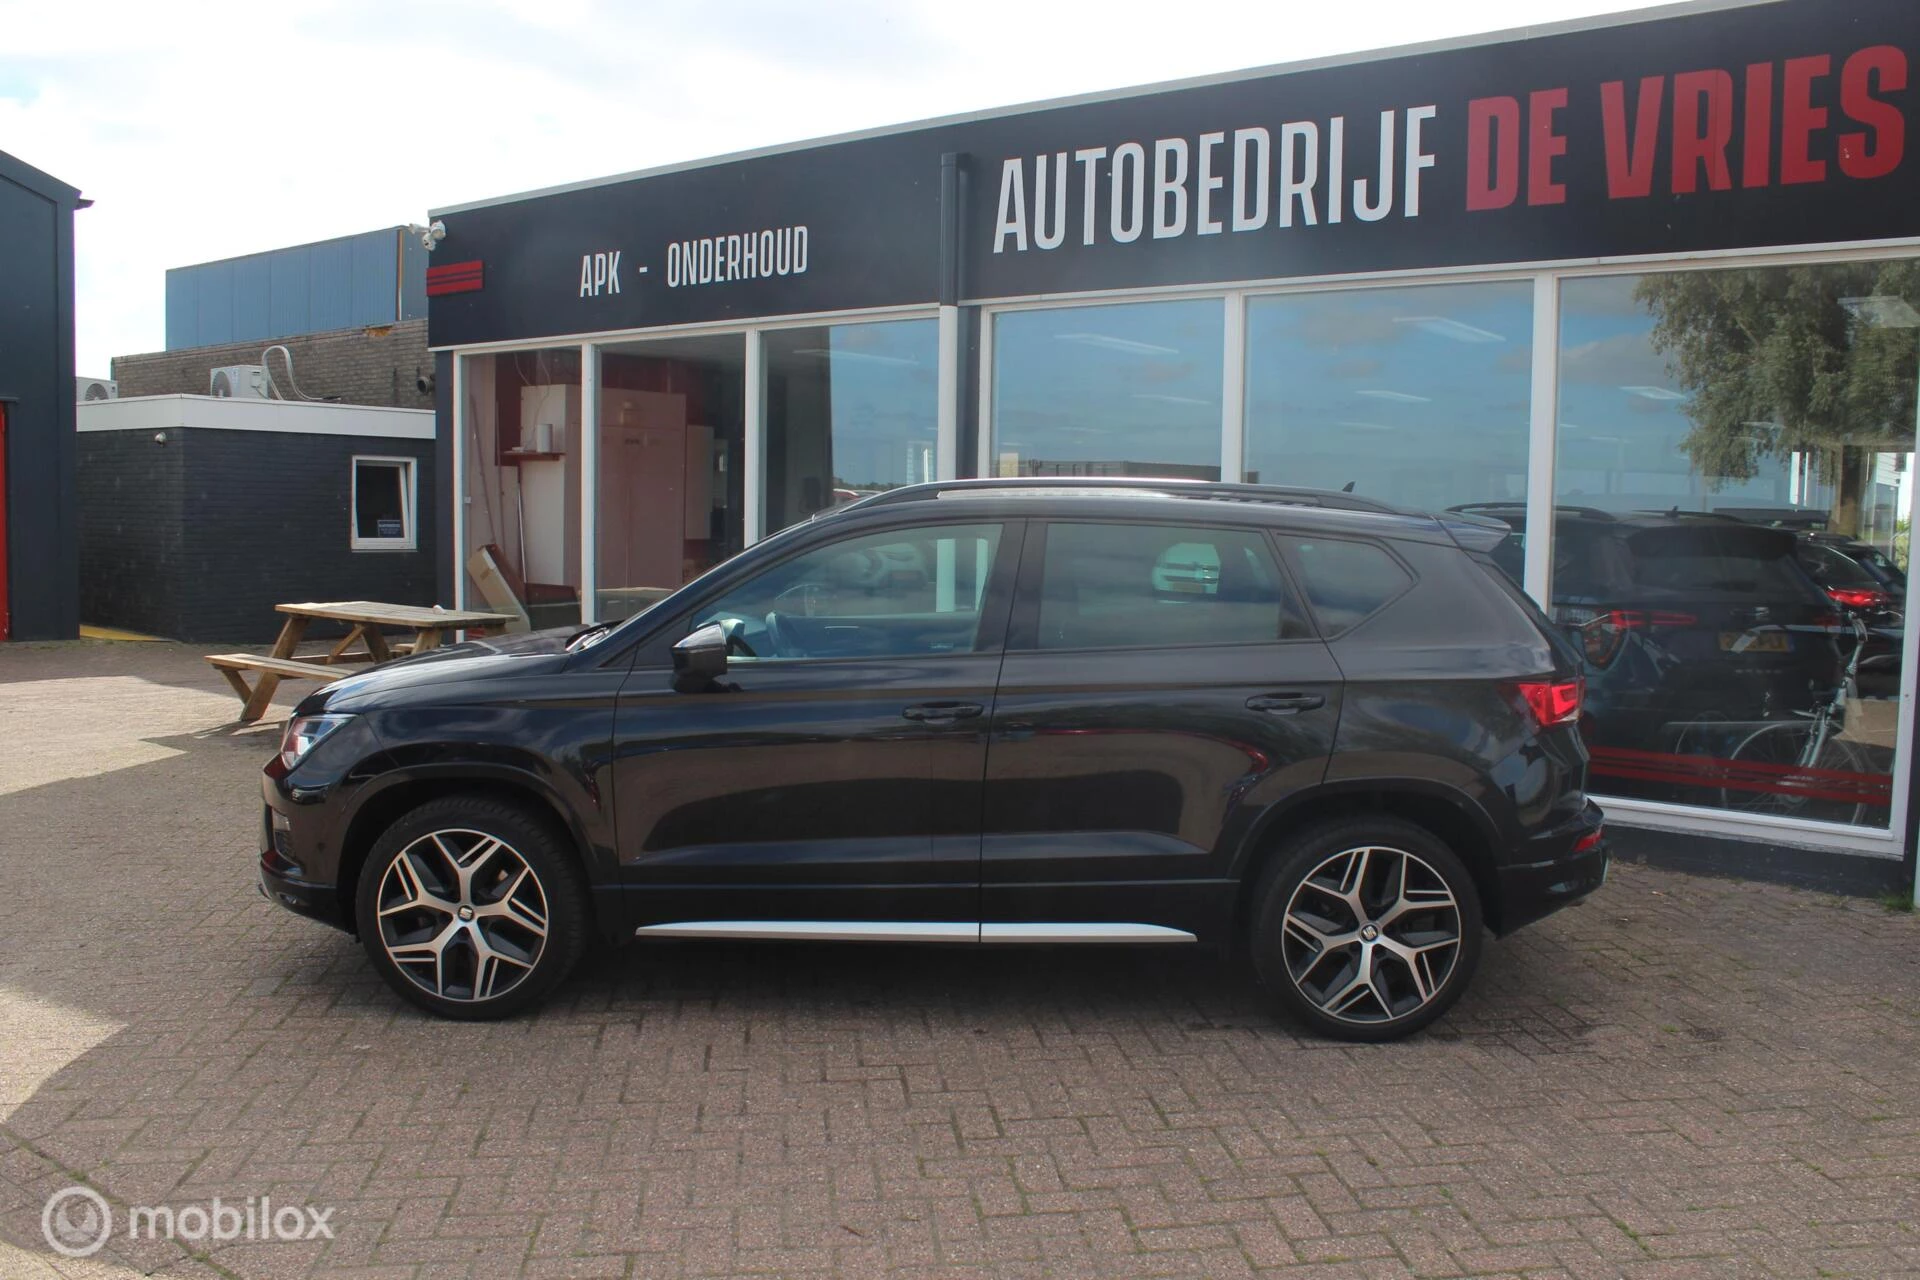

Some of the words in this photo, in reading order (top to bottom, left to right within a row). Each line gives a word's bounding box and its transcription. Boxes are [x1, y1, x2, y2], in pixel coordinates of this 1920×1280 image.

[993, 104, 1437, 254] AUTOBEDRIJF
[1467, 88, 1569, 211] DE
[1602, 45, 1908, 200] VRIES
[579, 251, 621, 298] APK
[667, 225, 808, 288] ONDERHOUD
